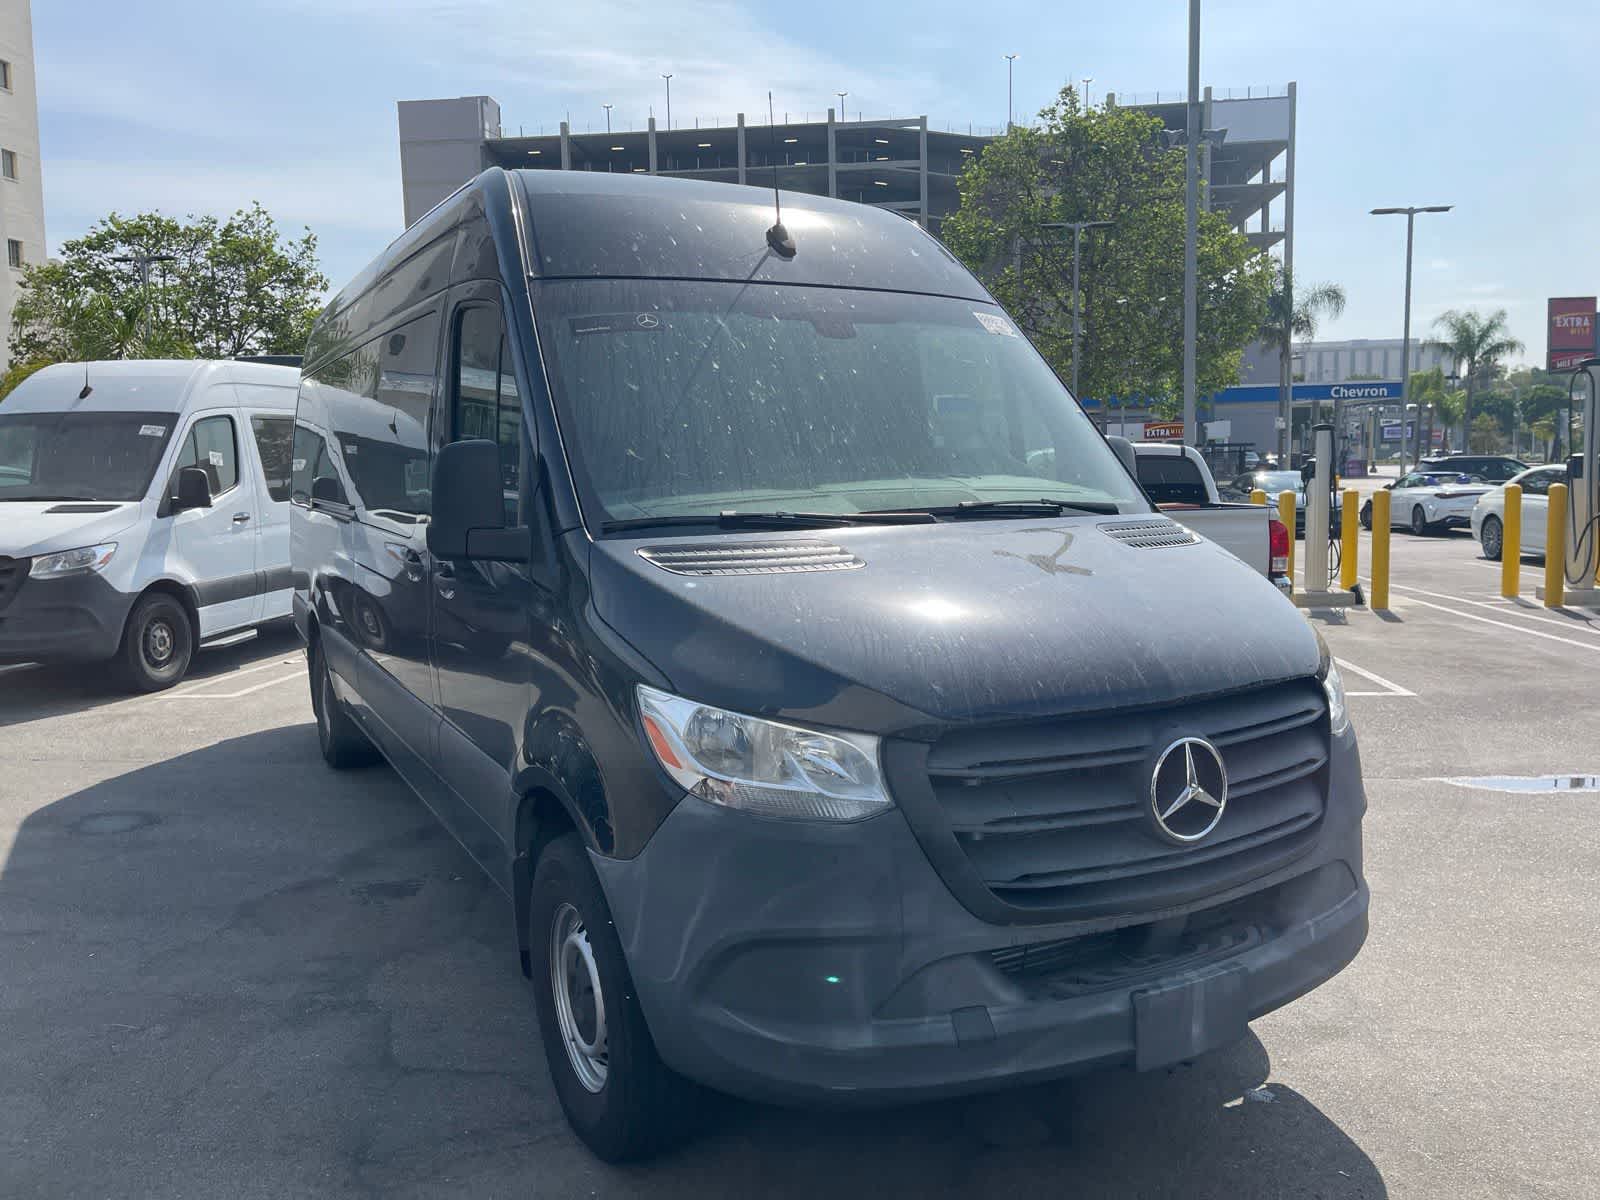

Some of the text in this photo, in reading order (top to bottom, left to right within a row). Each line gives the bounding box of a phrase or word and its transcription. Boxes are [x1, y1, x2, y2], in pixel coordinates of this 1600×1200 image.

[1555, 316, 1590, 327] EXTRA
[1330, 386, 1388, 398] Chevron
[1146, 428, 1169, 437] EXTRA
